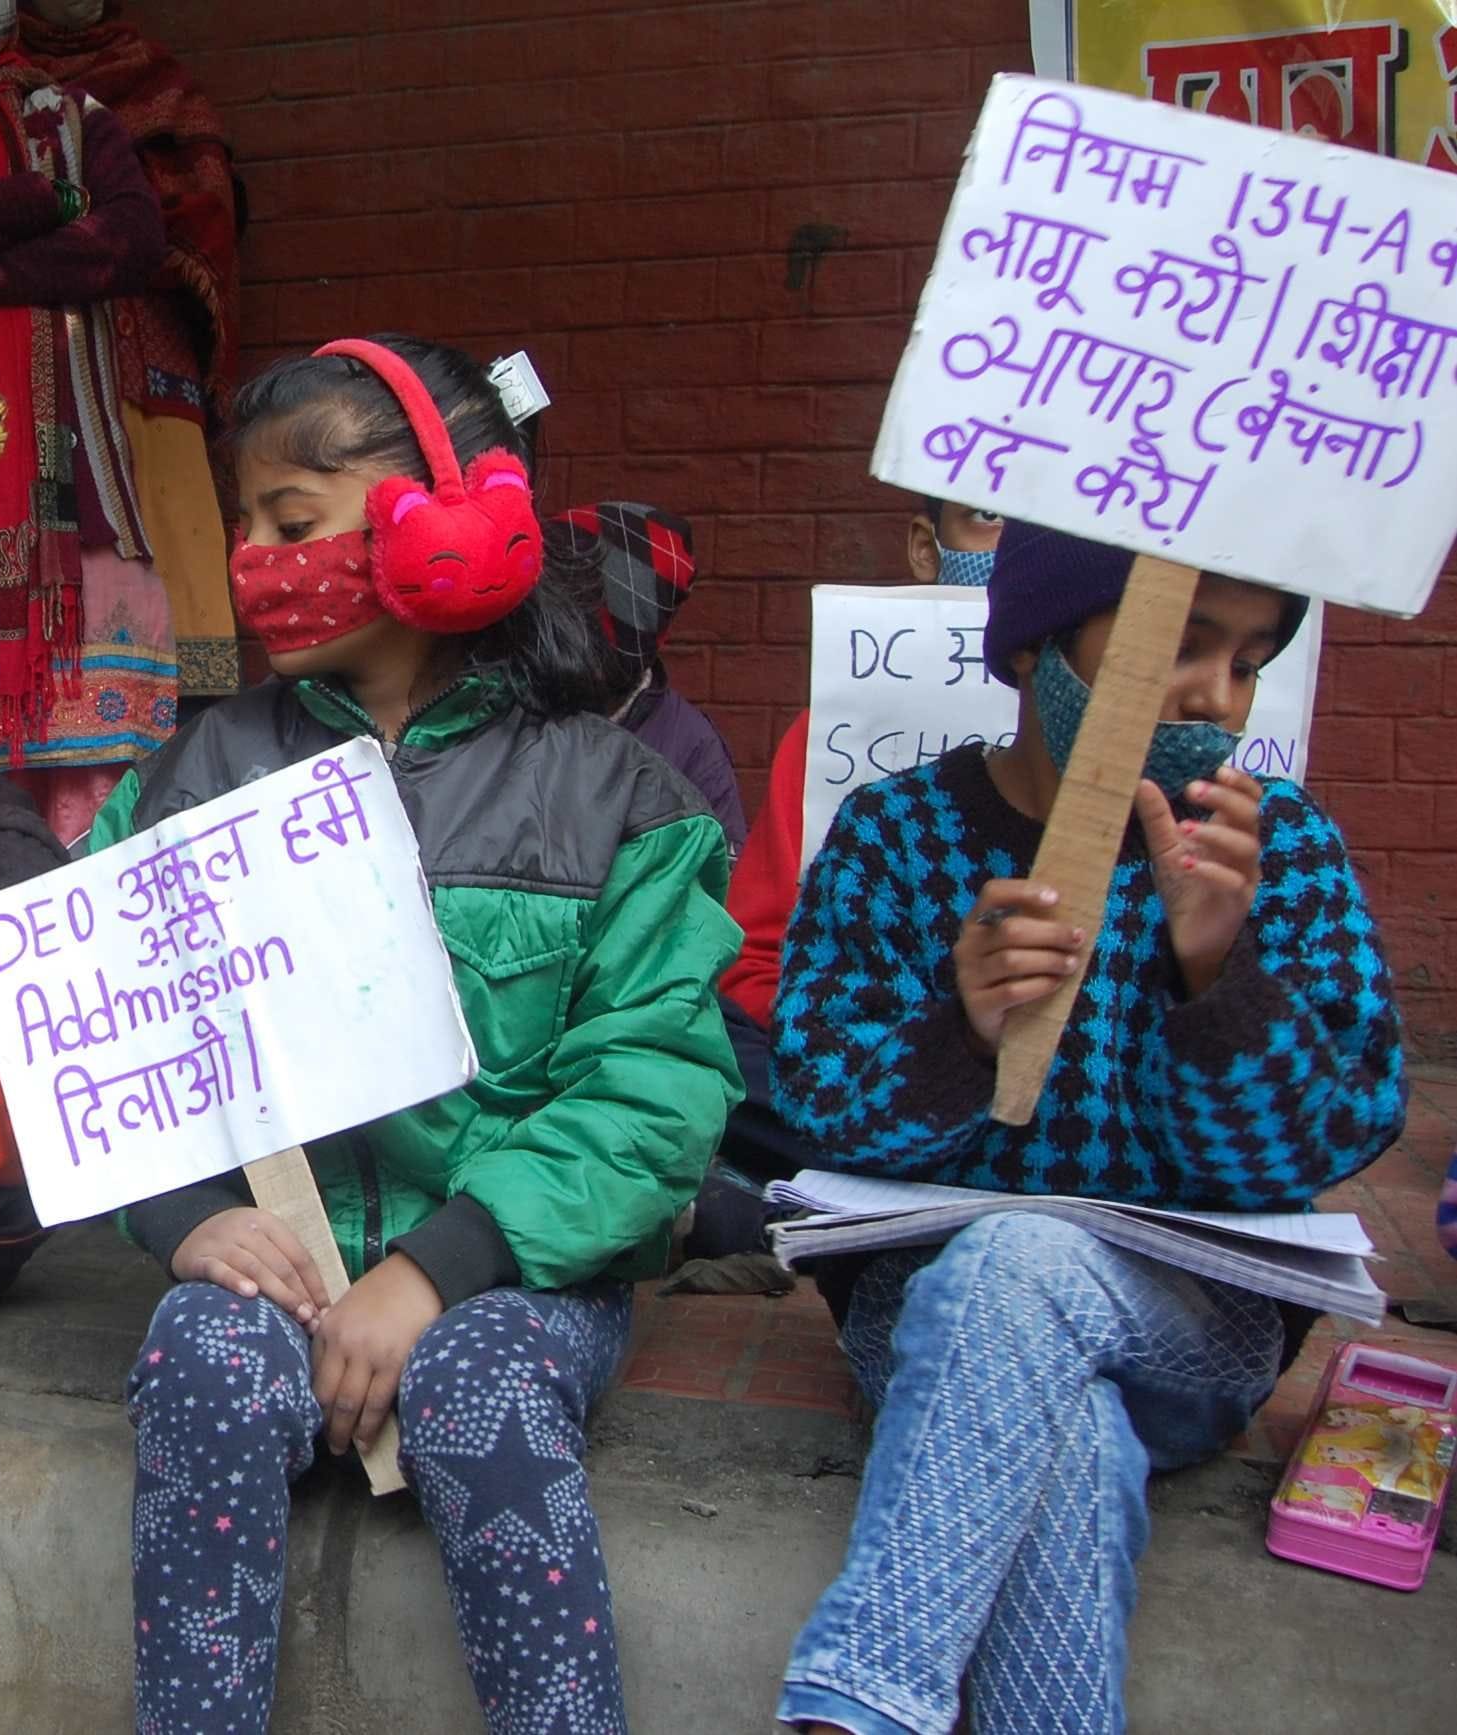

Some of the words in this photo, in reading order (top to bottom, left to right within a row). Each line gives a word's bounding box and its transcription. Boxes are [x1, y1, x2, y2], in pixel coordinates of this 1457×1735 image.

[1002, 92, 1206, 209] नियम
[1226, 172, 1412, 274] 134-A
[962, 211, 1109, 315] लागू
[850, 629, 917, 681] DC
[15, 935, 295, 1066] Addmission
